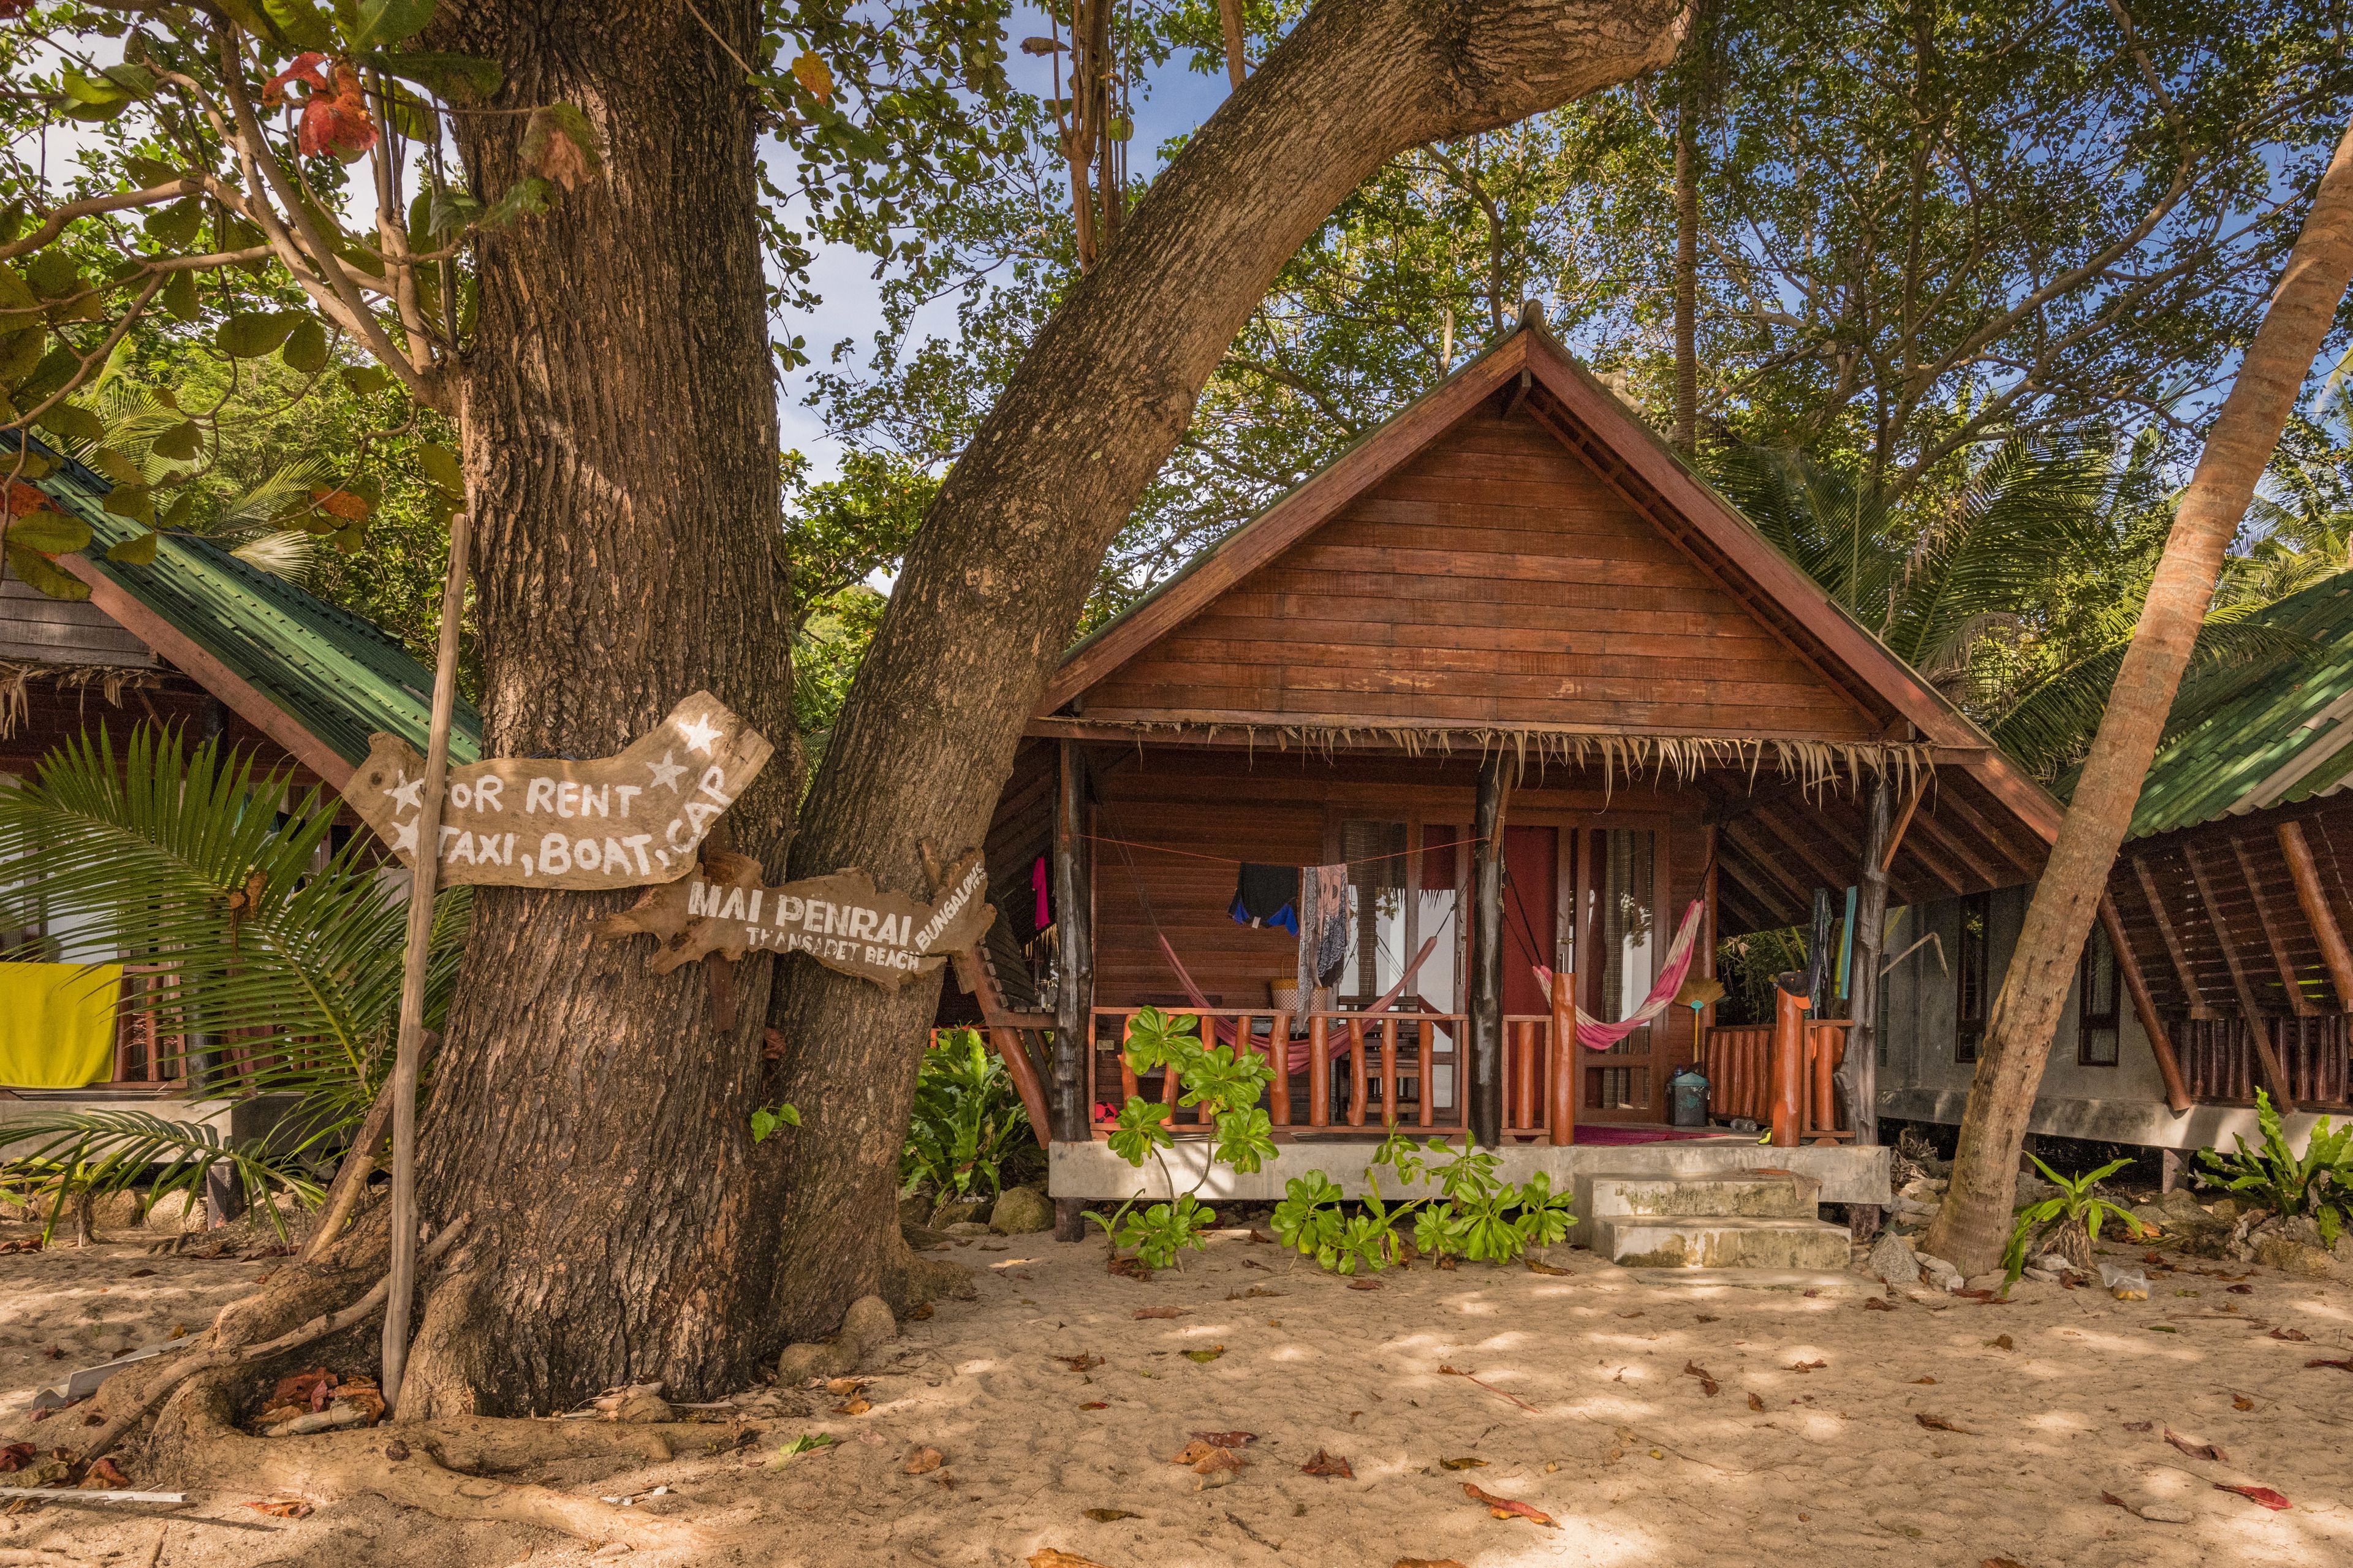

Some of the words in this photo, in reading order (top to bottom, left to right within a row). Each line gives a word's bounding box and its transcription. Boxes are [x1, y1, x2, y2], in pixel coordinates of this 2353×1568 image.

[445, 775, 504, 814] OR
[525, 776, 642, 819] RENT
[688, 881, 764, 922] MAI
[775, 895, 912, 947] PENRAI
[914, 862, 987, 953] BUNGALOWS
[864, 945, 920, 971] BEACH
